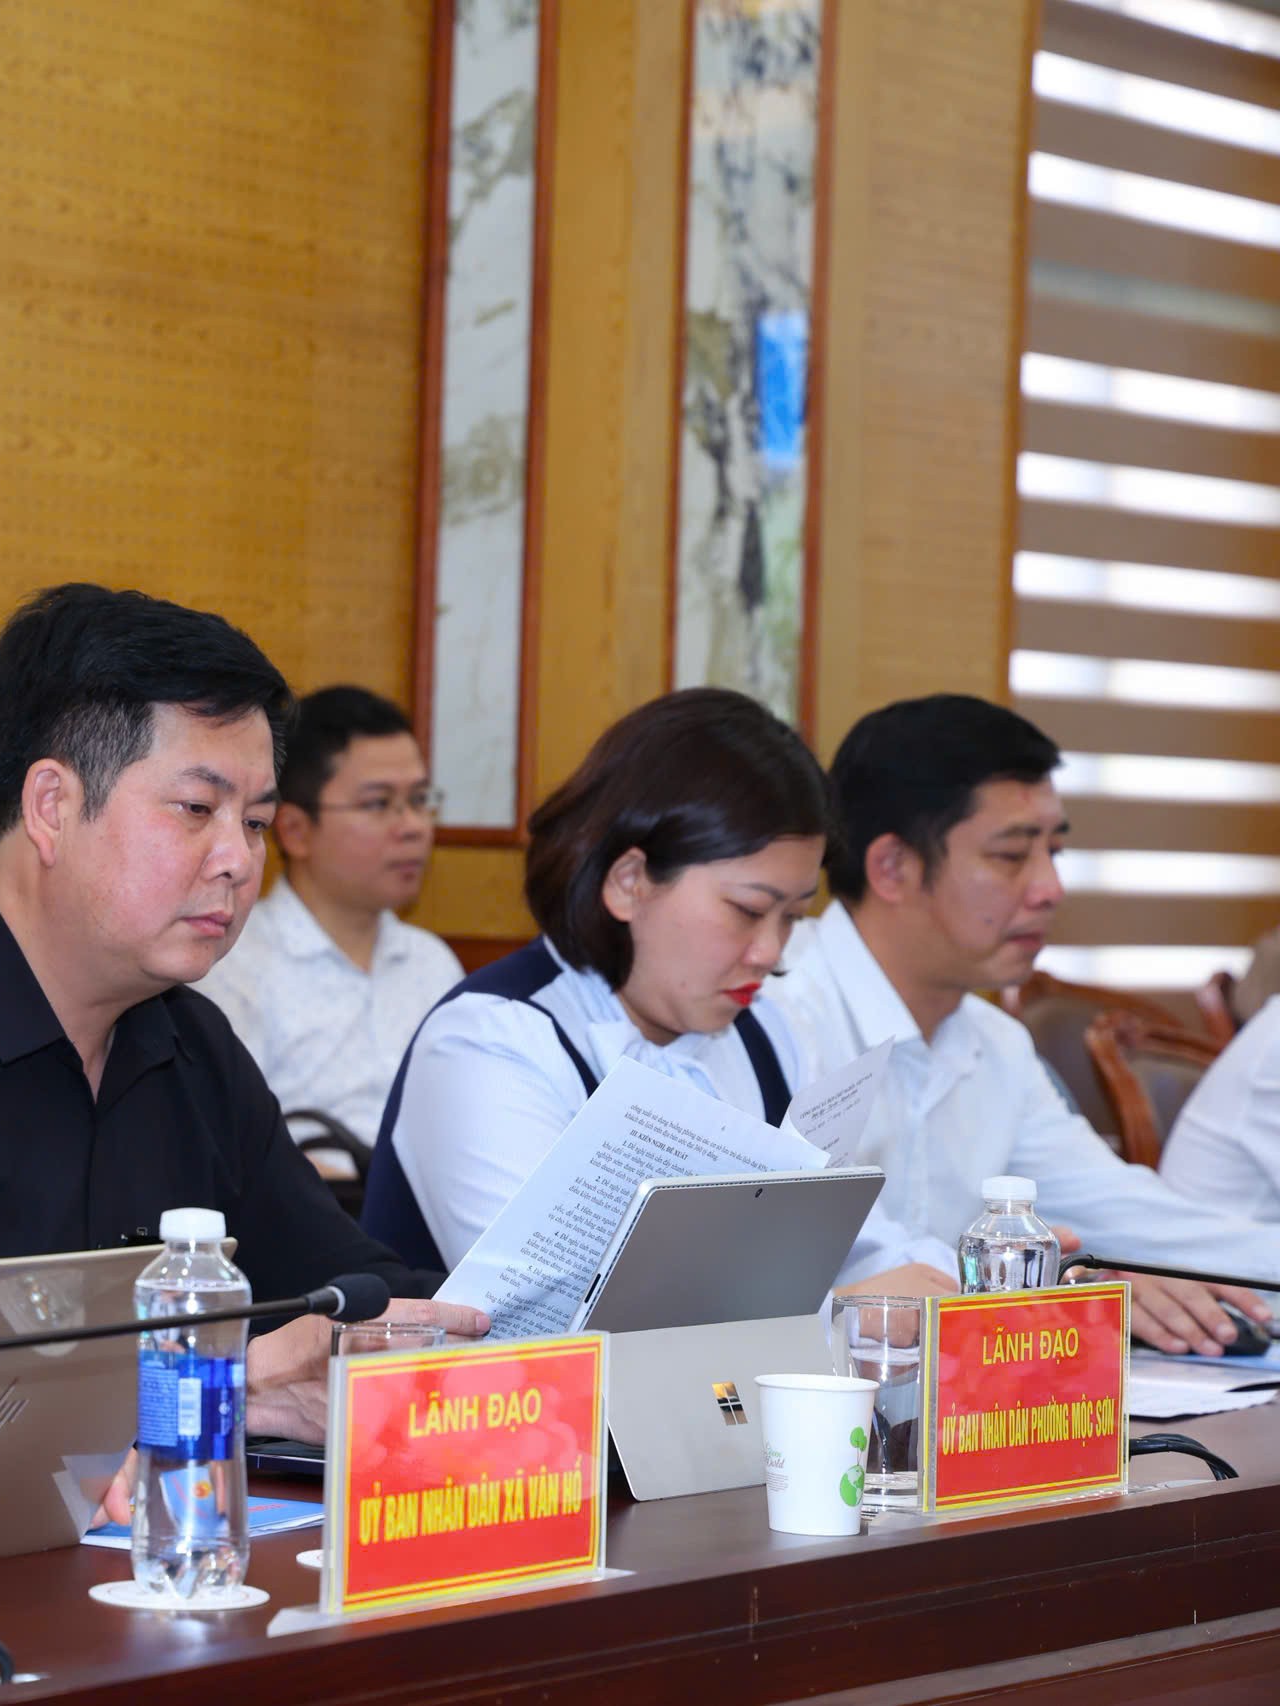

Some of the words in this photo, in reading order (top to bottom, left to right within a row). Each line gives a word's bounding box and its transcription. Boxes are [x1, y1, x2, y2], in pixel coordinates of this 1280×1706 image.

[982, 1327, 1033, 1365] LÃNH
[1039, 1327, 1079, 1365] ĐẠO
[409, 1390, 479, 1438] LÃNH
[487, 1387, 541, 1432] ĐẠO
[958, 1413, 979, 1454] BAN
[981, 1402, 1007, 1451] NHÂN
[1008, 1400, 1029, 1447] DÂN
[1031, 1395, 1069, 1444] PHƯỜNG
[1071, 1393, 1094, 1447] MỘC
[1095, 1395, 1115, 1437] SƠN
[384, 1492, 419, 1543] BAN
[421, 1475, 465, 1536] NHÂN
[467, 1471, 501, 1529] DÂN
[503, 1467, 525, 1524] XÃ
[528, 1464, 560, 1520] VÂN
